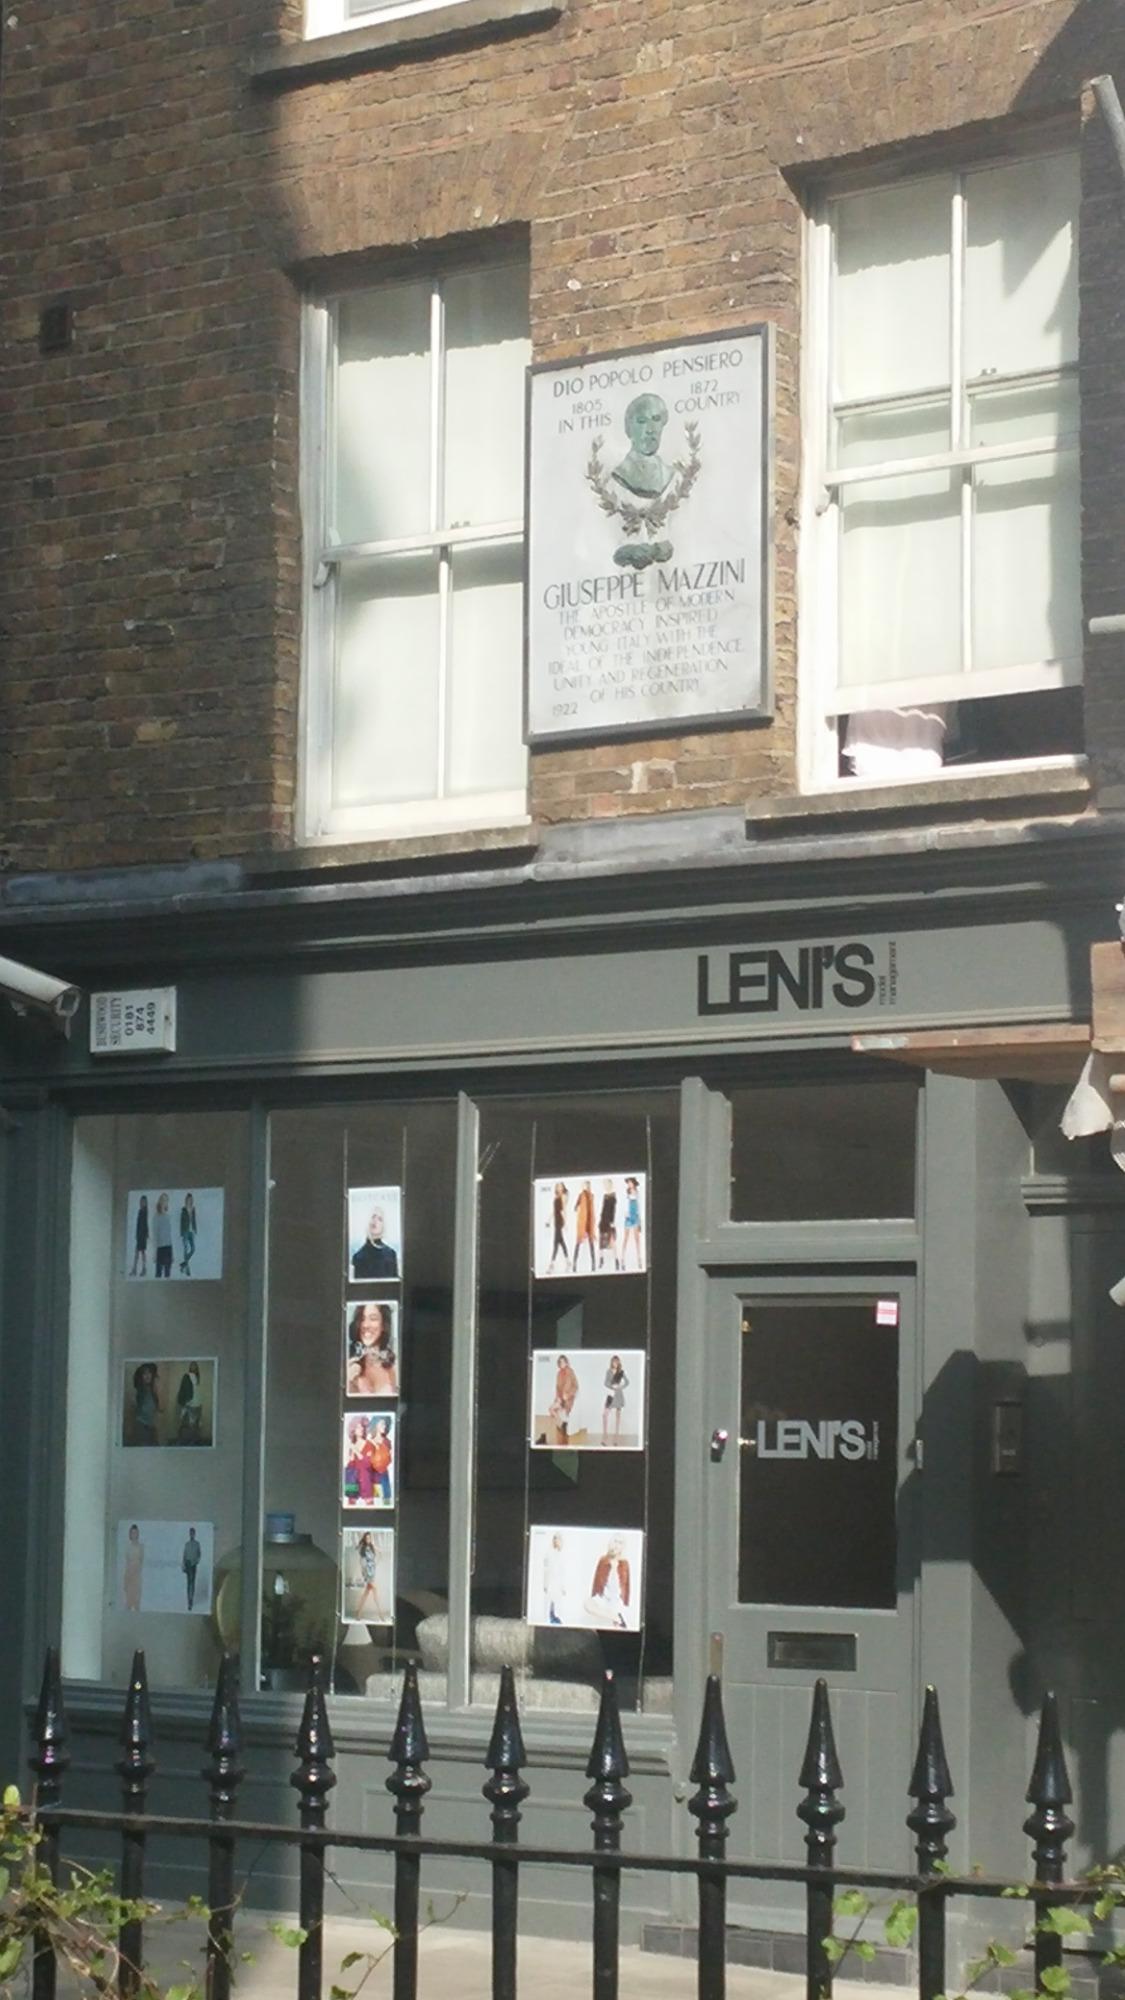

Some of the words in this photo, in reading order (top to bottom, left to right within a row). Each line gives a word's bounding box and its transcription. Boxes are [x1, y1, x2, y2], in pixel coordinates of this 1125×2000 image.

[553, 378, 584, 397] DIO
[589, 366, 653, 390] POPOLO
[663, 350, 743, 378] PENSIERO
[559, 419, 574, 434] IN
[580, 413, 612, 430] THIS
[674, 391, 740, 414] COUNTRY
[572, 400, 602, 414] 1805
[690, 380, 718, 394] 1872
[544, 572, 645, 609] GIUSEPPE
[658, 558, 745, 593] MAZZINI
[559, 610, 579, 625] THE
[592, 601, 648, 620] APOSTLE
[655, 597, 672, 612] OF
[679, 590, 735, 607] MODERN
[564, 618, 645, 640] DEMOCRACY
[656, 610, 718, 628] INSPIRED
[566, 640, 608, 656] YOUNG
[617, 635, 649, 650] ITALY
[657, 629, 690, 645] WITH
[697, 625, 717, 639] THE
[549, 660, 582, 676] IDEAL
[588, 656, 604, 671] OF
[614, 651, 632, 666] THE
[643, 639, 742, 663] INDEPENDENCE
[553, 675, 591, 691] UNITY
[599, 670, 626, 685] AND
[631, 658, 728, 682] REGENERATION
[589, 689, 605, 703] OF
[615, 685, 636, 699] HIS
[641, 678, 700, 697] COUNTRY
[553, 703, 578, 717] 1922
[698, 943, 876, 1016] LENI'S
[135, 1007, 145, 1032] 874
[757, 1420, 866, 1460] LENI'S
